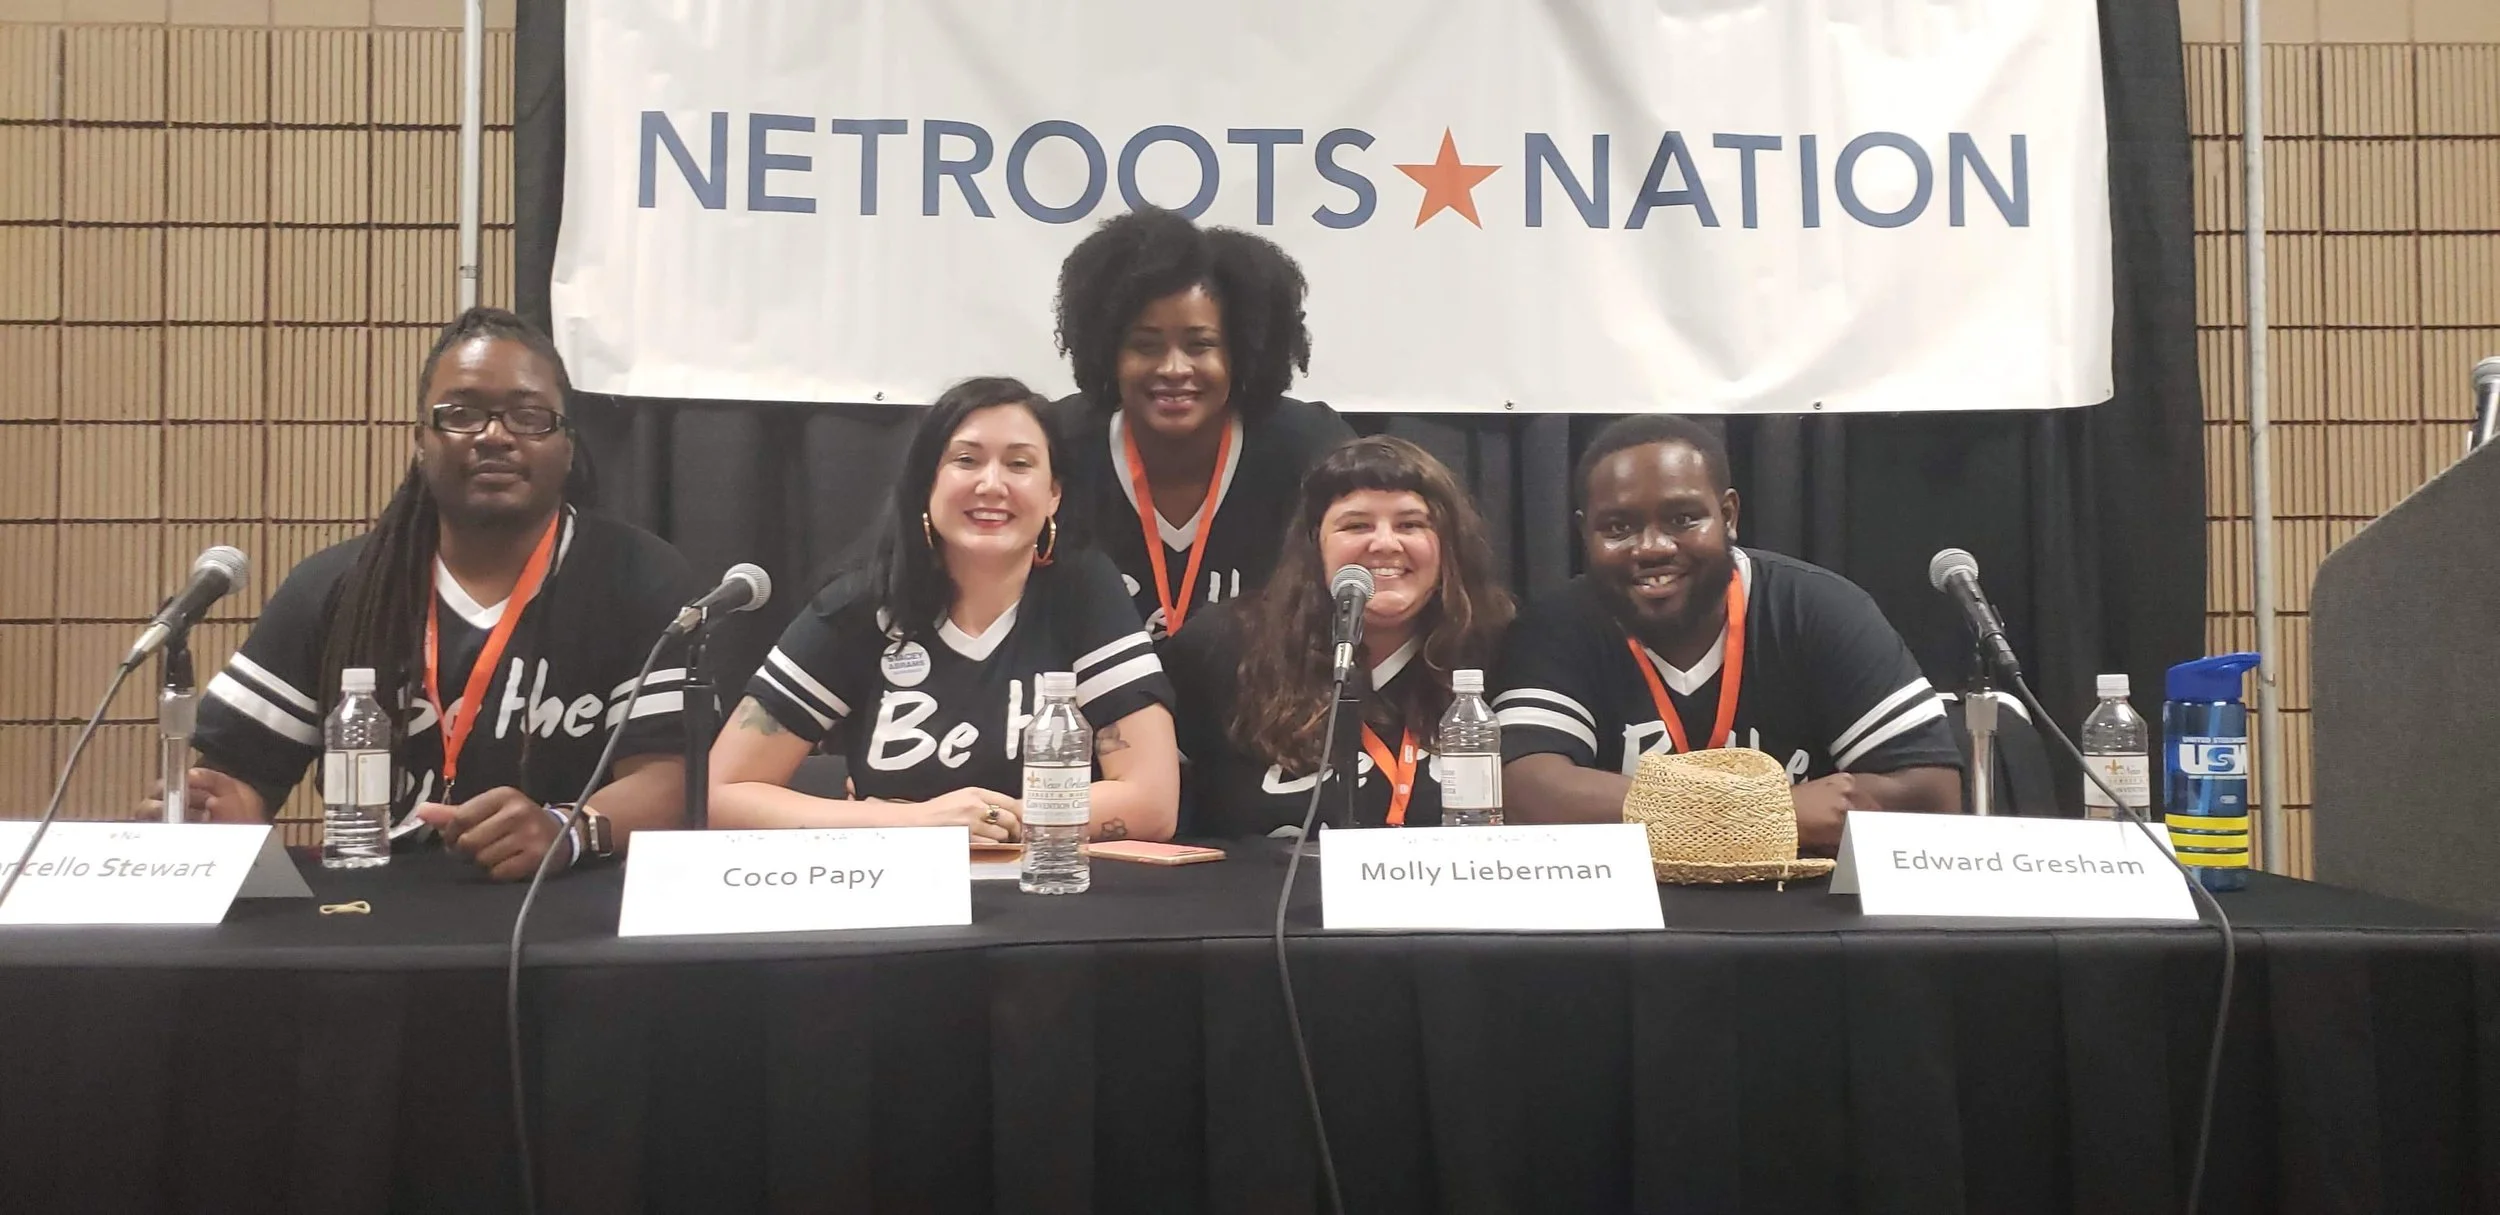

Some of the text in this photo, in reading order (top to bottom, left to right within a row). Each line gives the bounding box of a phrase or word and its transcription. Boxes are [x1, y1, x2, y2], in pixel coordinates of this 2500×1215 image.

[638, 109, 2030, 230] NETROOTS NATION
[494, 657, 604, 740] the
[867, 690, 979, 771] Be
[0, 856, 217, 877] rcello Stewart
[1361, 859, 1612, 887] Molly Lieberman
[1892, 849, 2145, 875] Edward Gresham
[723, 866, 885, 890] Coco Papy
